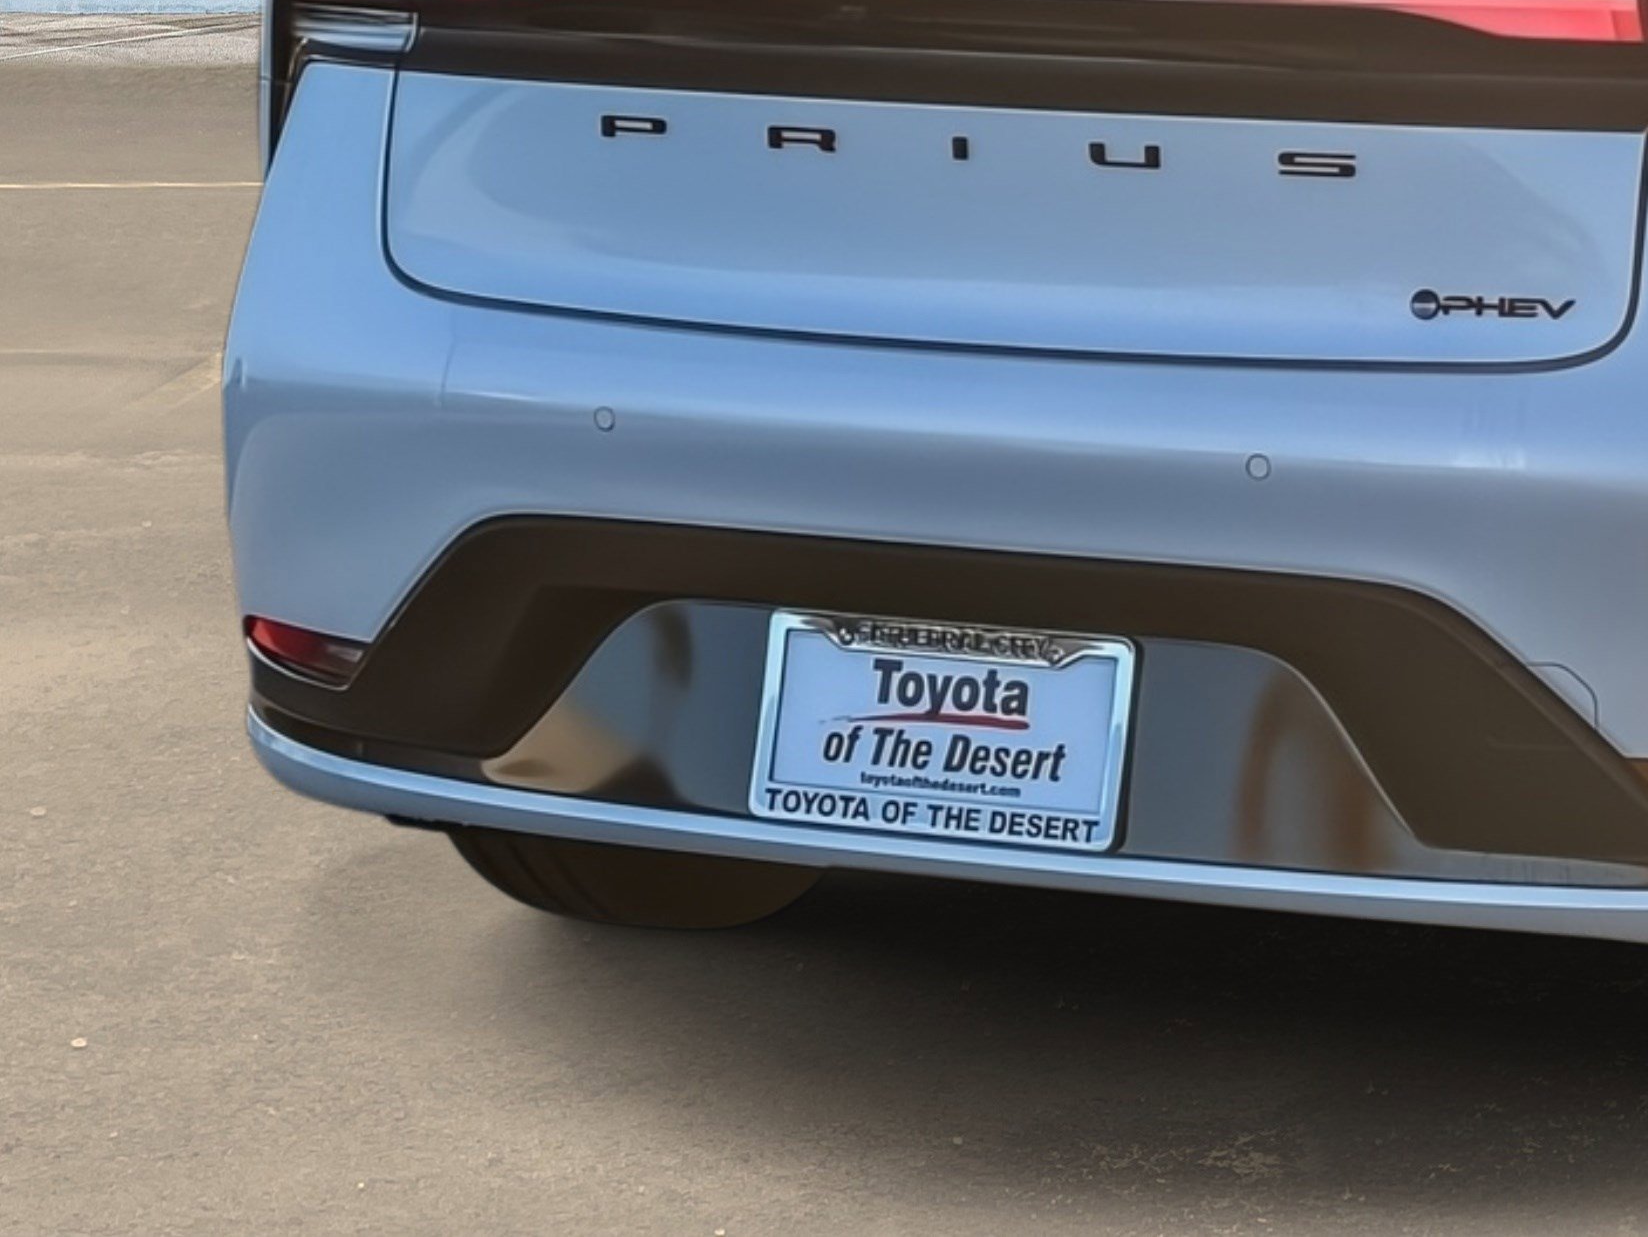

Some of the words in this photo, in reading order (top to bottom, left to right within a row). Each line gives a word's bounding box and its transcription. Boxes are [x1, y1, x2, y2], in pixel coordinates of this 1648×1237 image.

[600, 114, 1357, 178] PRIUS
[873, 658, 1030, 719] Toyota
[822, 724, 865, 764] of
[870, 726, 934, 770] The
[942, 734, 1068, 783] Desert
[859, 770, 1022, 799] toyotaofthedesert.com
[765, 787, 871, 822] TOYOTA
[881, 799, 918, 826] OF
[926, 803, 981, 832] THE
[988, 810, 1100, 844] DESERT
